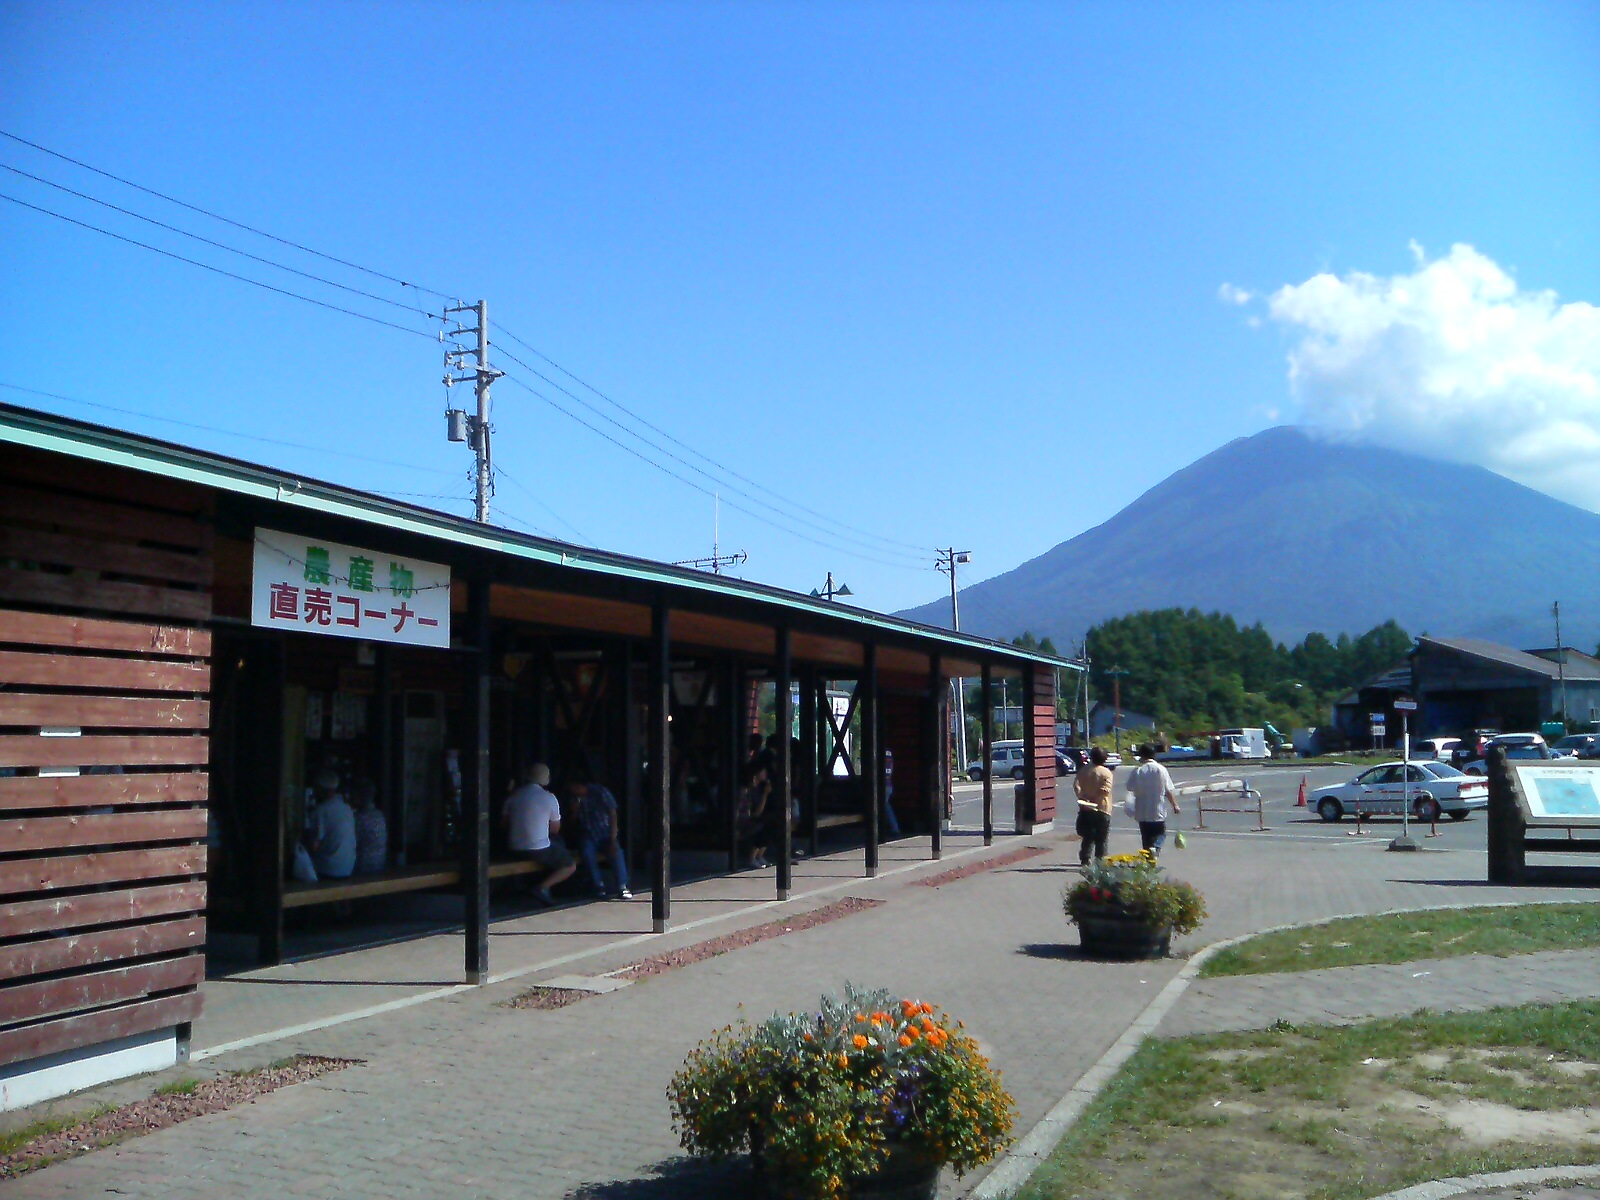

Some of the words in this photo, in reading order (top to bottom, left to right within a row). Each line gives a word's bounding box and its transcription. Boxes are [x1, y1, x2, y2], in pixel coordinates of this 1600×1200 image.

[303, 546, 414, 598] 農産物
[269, 582, 439, 633] 直売コーナー
